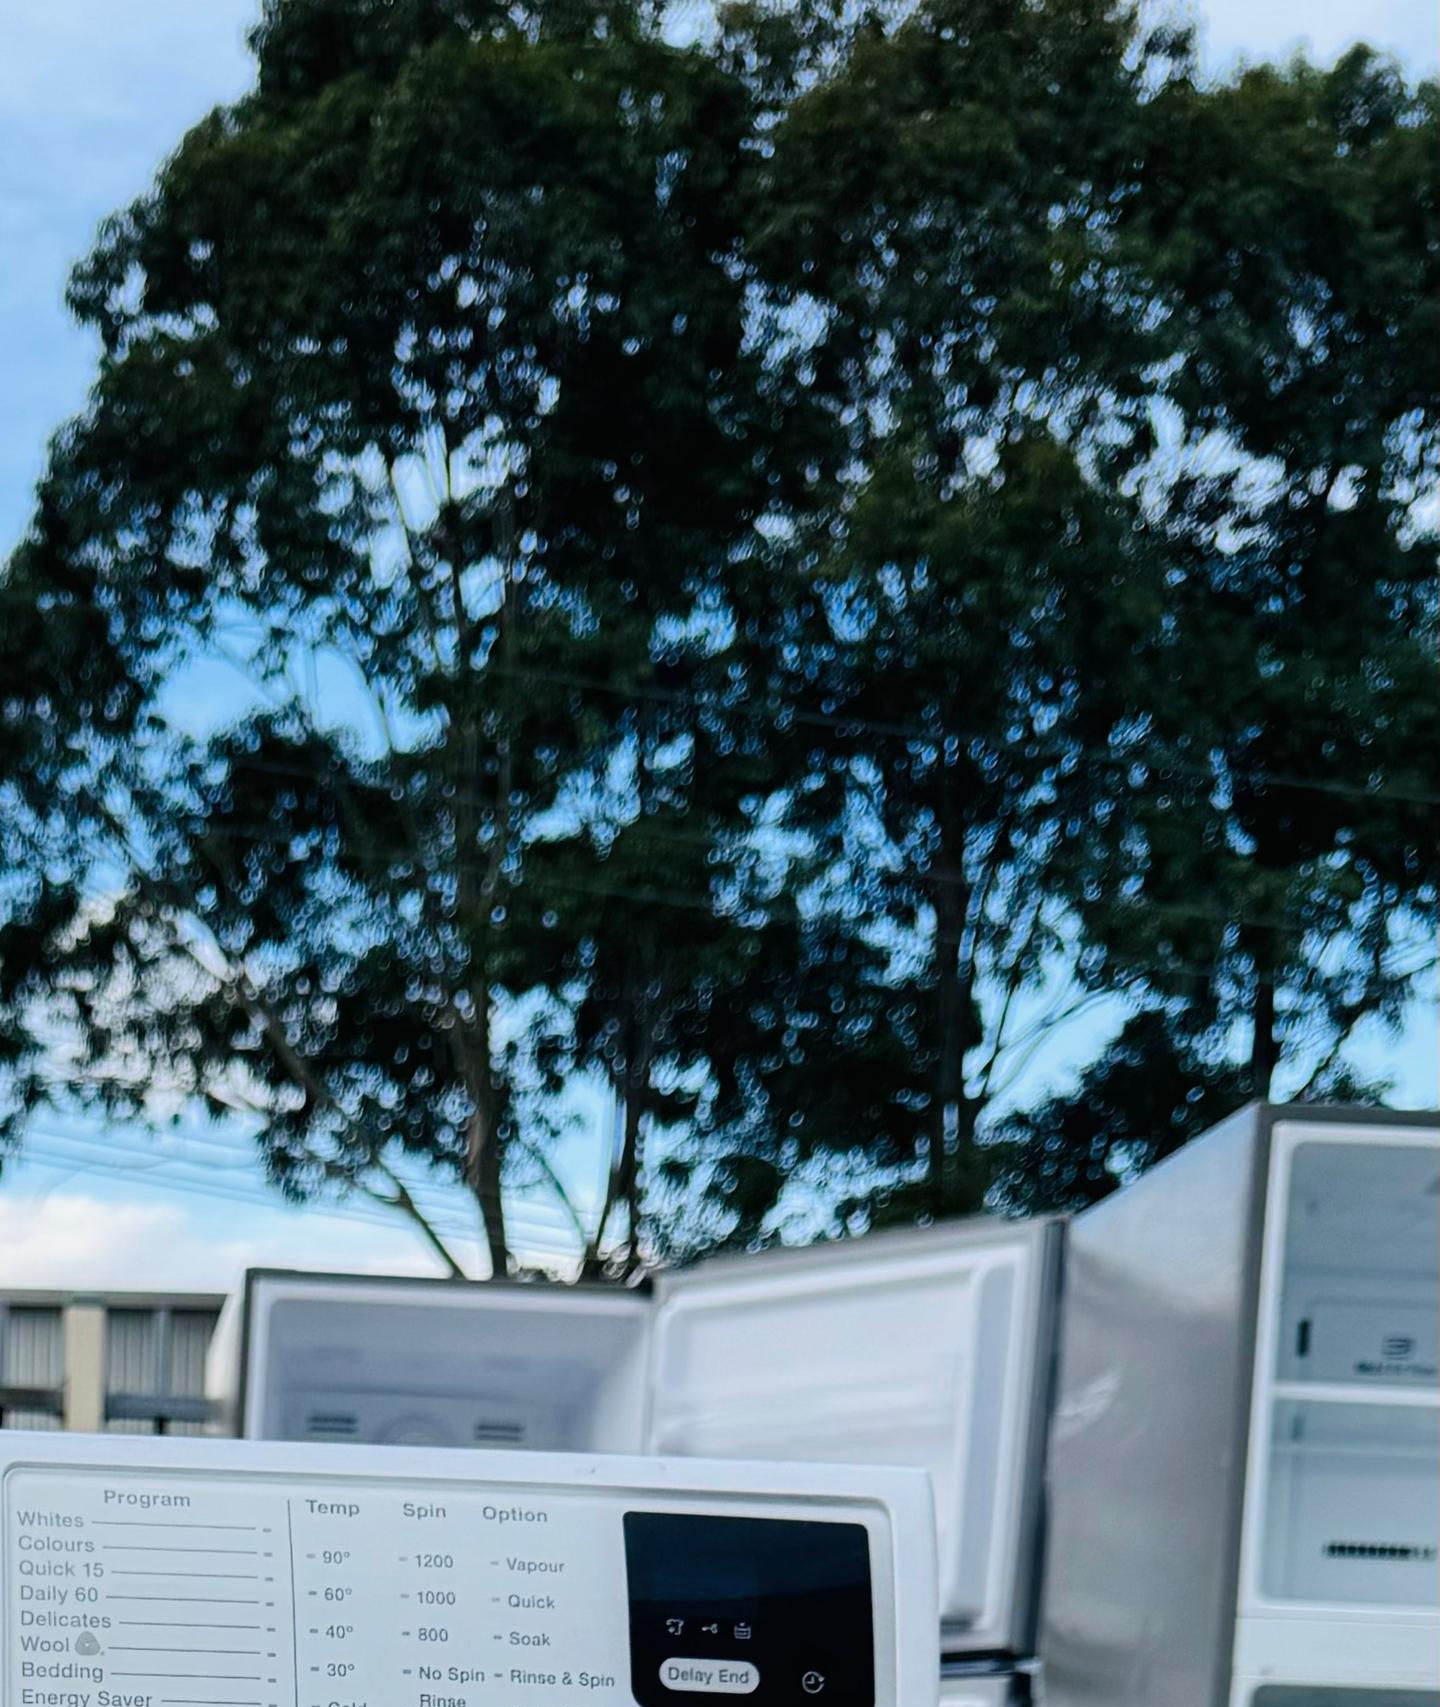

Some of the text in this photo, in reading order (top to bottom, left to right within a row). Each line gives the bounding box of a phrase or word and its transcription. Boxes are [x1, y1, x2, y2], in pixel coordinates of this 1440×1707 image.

[103, 1489, 191, 1509] Program
[306, 1499, 360, 1517] Temp
[17, 1511, 84, 1528] Whites
[403, 1503, 446, 1520] Spin
[482, 1506, 547, 1524] Option
[18, 1535, 95, 1553] Colours
[19, 1560, 104, 1578] Quick 15
[415, 1555, 454, 1569] 1200
[506, 1558, 564, 1575] Vapour
[20, 1585, 99, 1605] Daily 60
[417, 1591, 456, 1605] 1000
[508, 1594, 555, 1610] Quick
[21, 1610, 111, 1628] Delicates
[20, 1635, 70, 1652] Wool
[418, 1628, 448, 1642] 800
[509, 1632, 551, 1647] Soak
[22, 1662, 103, 1683] Bedding
[419, 1666, 485, 1684] No Spin
[510, 1670, 615, 1689] Rinse & Spin
[668, 1667, 749, 1685] Delay End
[97, 1690, 152, 1707] Saver
